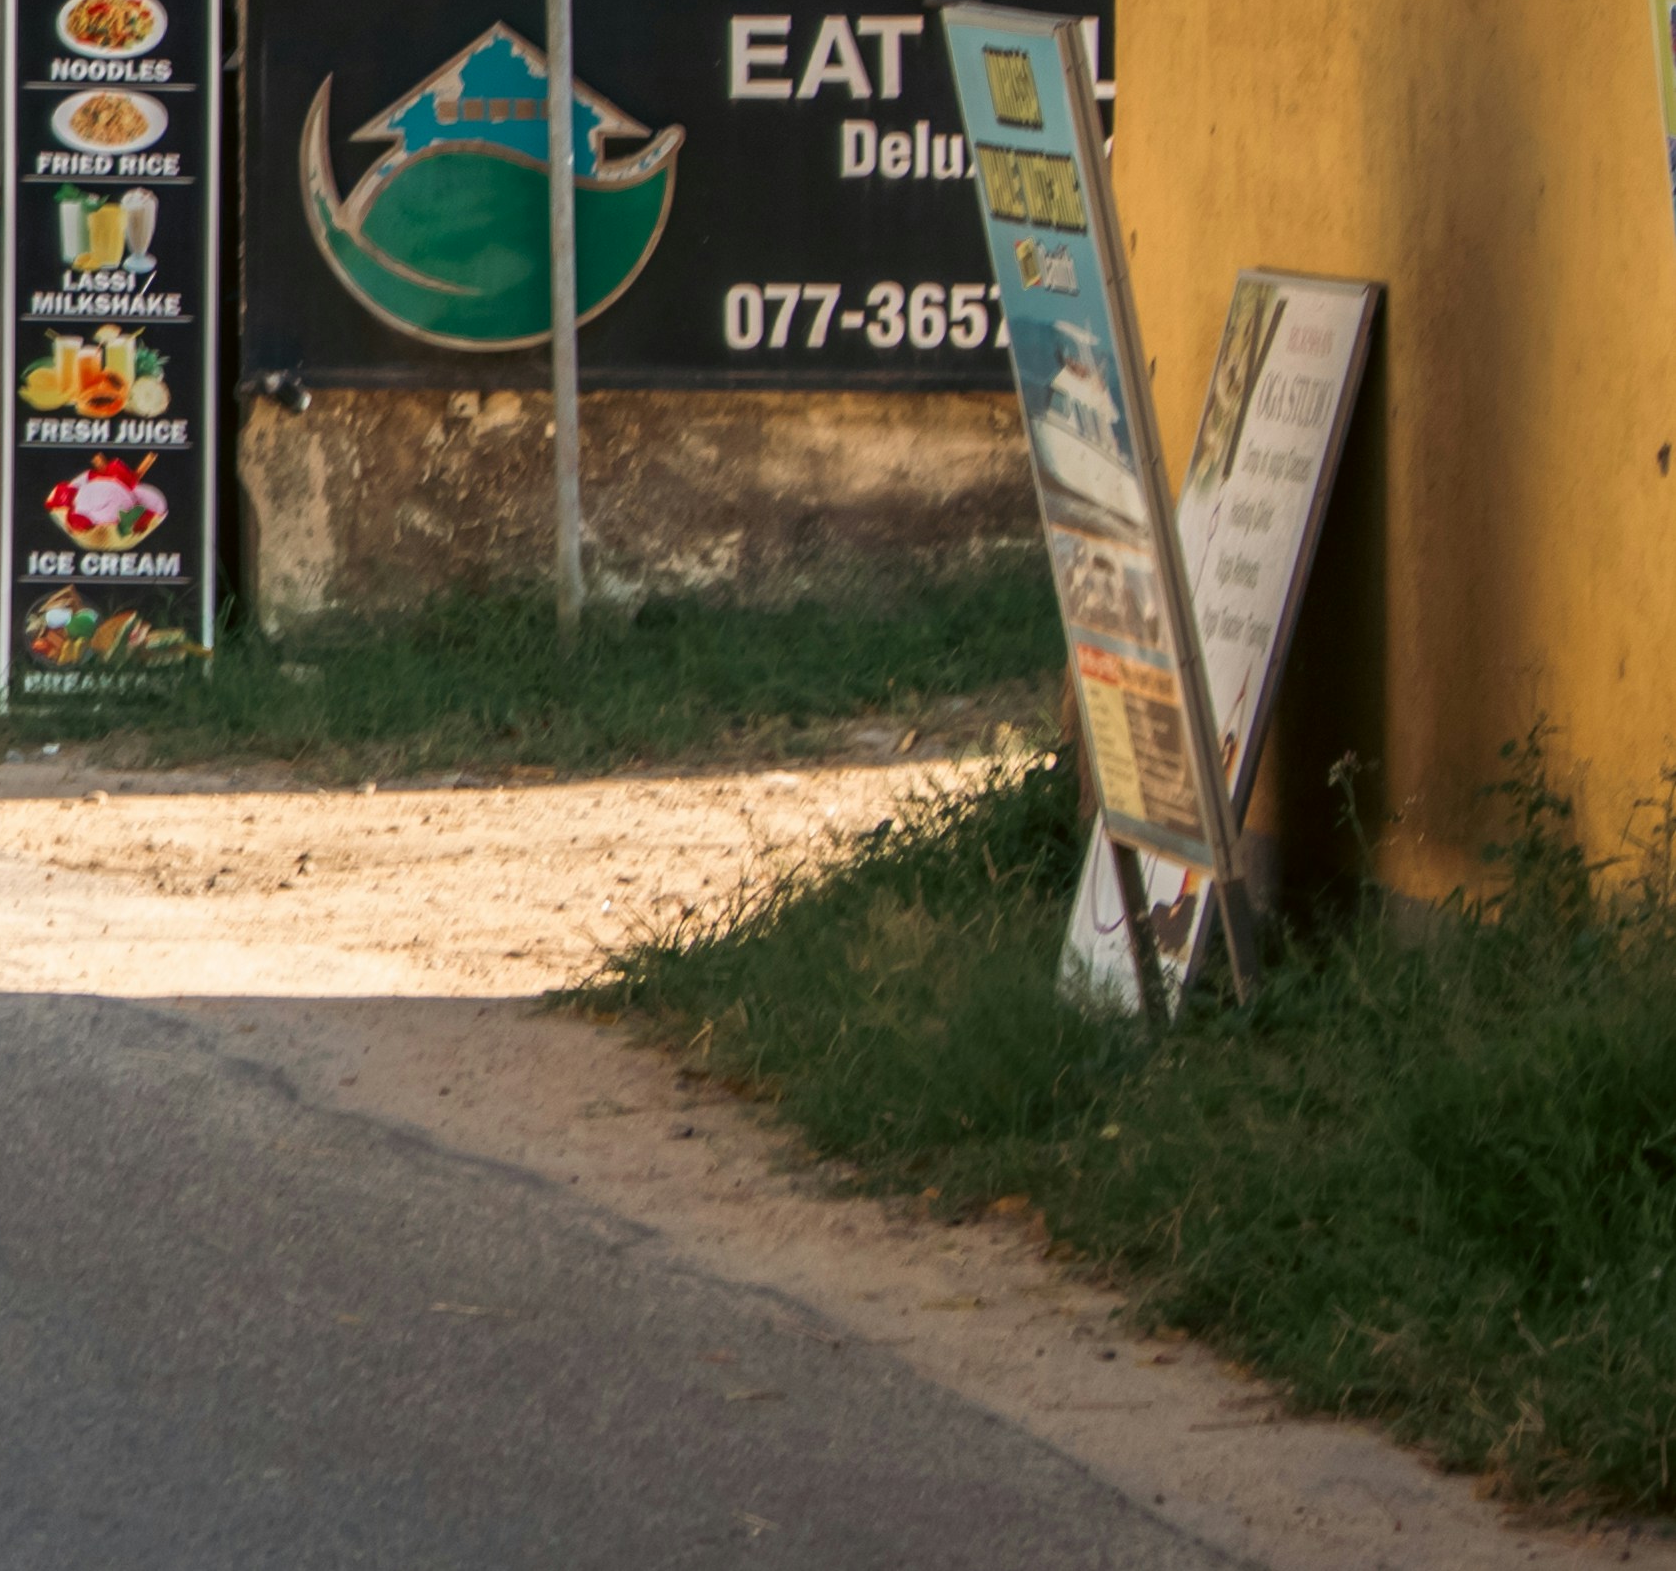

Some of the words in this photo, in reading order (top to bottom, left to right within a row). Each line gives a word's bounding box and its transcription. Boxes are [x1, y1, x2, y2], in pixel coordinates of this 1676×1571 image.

[50, 58, 173, 83] NOODLES
[728, 14, 925, 100] EAT
[36, 150, 114, 176] FRIED
[118, 152, 182, 177] RICE
[840, 120, 978, 180] Delu
[63, 269, 137, 293] LASSI
[31, 291, 183, 317] MILKSHAKE
[25, 417, 112, 444] FRESH
[114, 418, 189, 445] JUICE
[28, 550, 77, 577] ICE
[80, 551, 182, 578] CREAM
